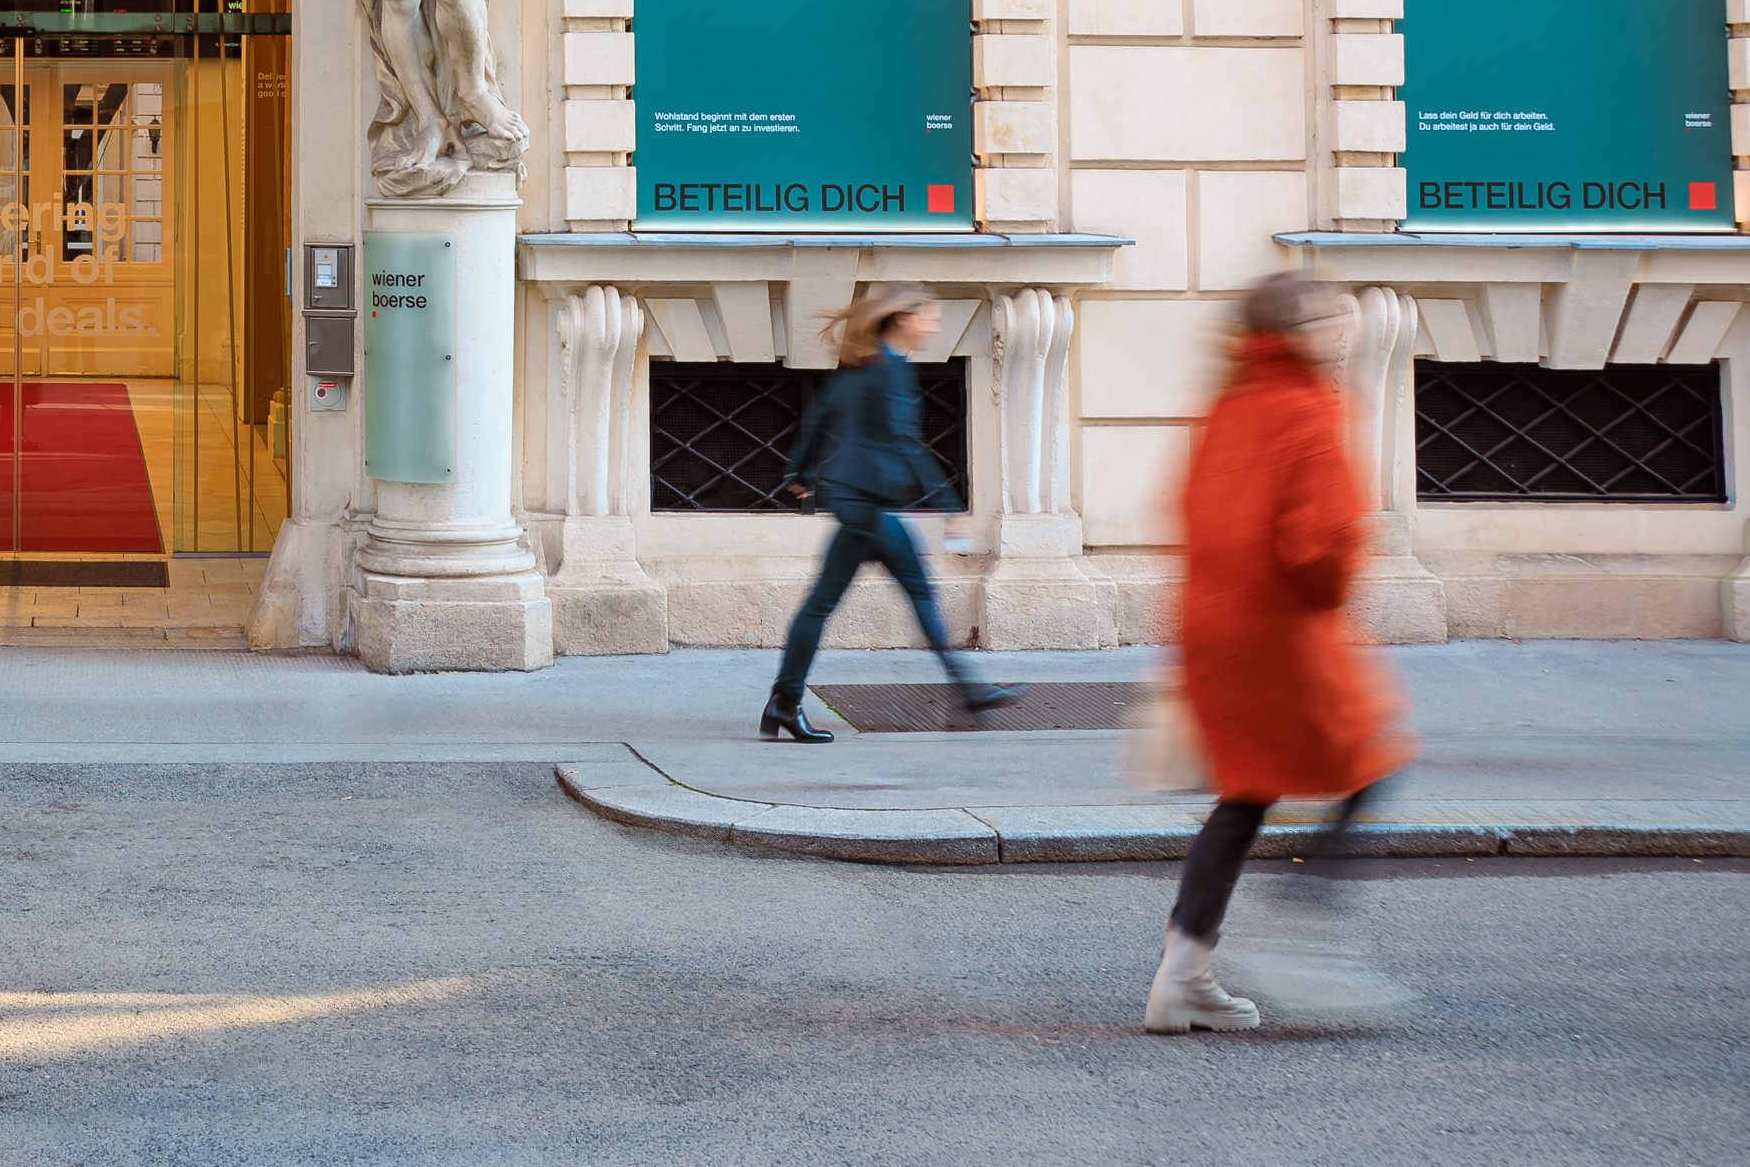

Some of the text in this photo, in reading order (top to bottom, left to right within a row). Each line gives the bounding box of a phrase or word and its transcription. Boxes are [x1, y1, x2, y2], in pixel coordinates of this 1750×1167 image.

[654, 111, 796, 123] Wohlstand beginnt mit dem ersten
[926, 113, 952, 121] wiener
[1418, 110, 1549, 120] Lass dein Geld für dich arbeiten.
[1684, 111, 1711, 120] wiener
[654, 122, 685, 132] Schritt.
[686, 123, 708, 134] Fang
[709, 123, 728, 134] jetzt
[753, 123, 801, 133] investieren.
[926, 121, 953, 129] boerse
[1418, 121, 1556, 133] Du arbeitest ja auch für dein Geld.
[1685, 119, 1712, 127] boerse
[654, 183, 905, 213] BETEILIG DICH
[1419, 181, 1666, 210] BETEILIG DICH
[70, 244, 119, 284] of
[371, 269, 425, 288] wiener
[372, 290, 427, 309] boerse
[18, 296, 157, 336] deals.
